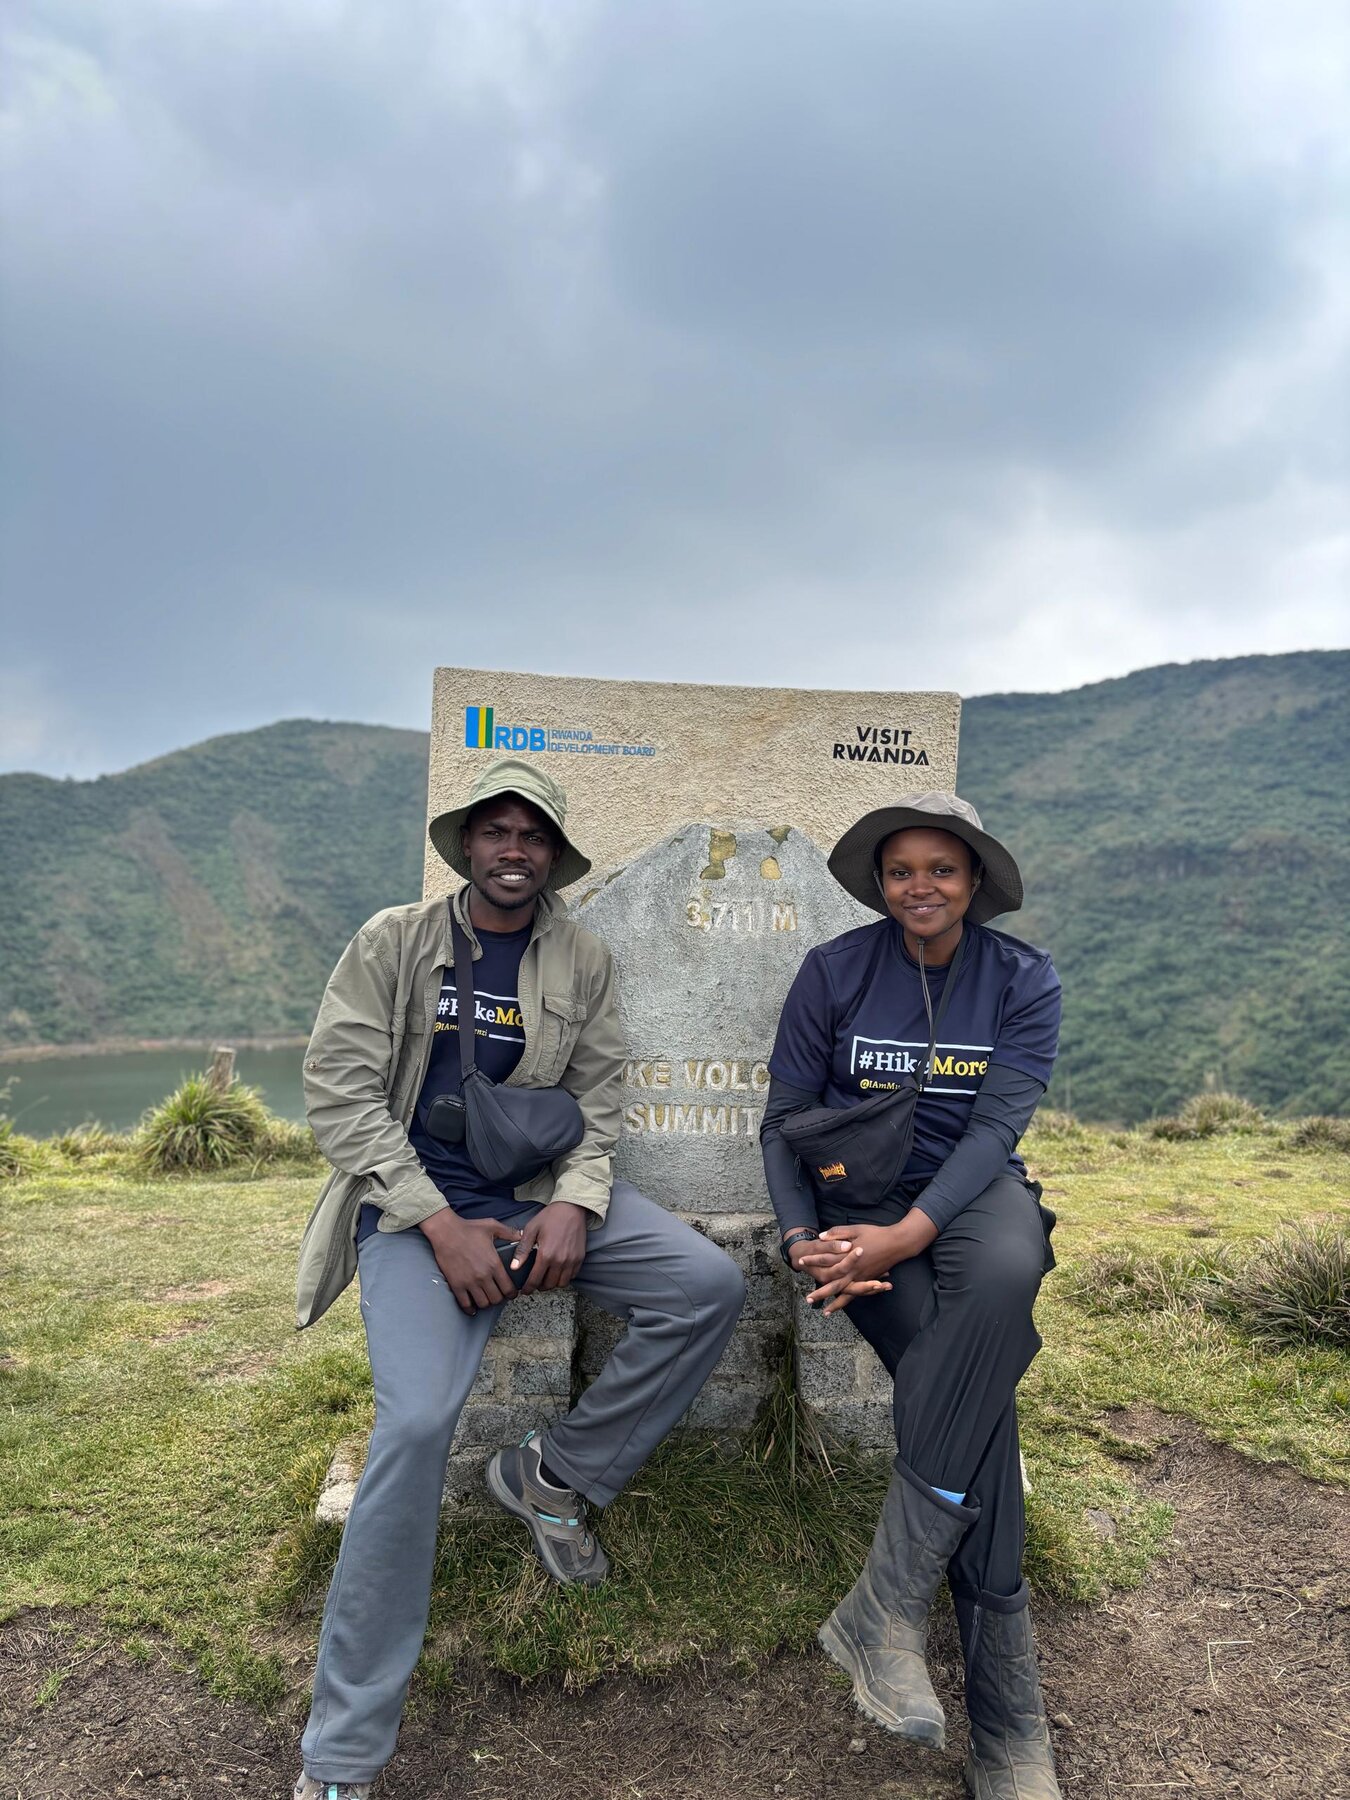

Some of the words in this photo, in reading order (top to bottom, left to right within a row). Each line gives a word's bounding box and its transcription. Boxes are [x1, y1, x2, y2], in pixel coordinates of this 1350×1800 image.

[495, 726, 546, 752] RDB
[551, 730, 593, 741] RWANDA
[856, 726, 912, 746] VISIT
[551, 743, 622, 756] DEVELOPMENT
[622, 745, 656, 757] BOARD
[833, 743, 930, 766] RWANDA
[772, 902, 798, 932] M
[623, 1060, 671, 1089] KE
[684, 1060, 771, 1092] VOLC
[625, 1102, 763, 1136] SUMMIT
